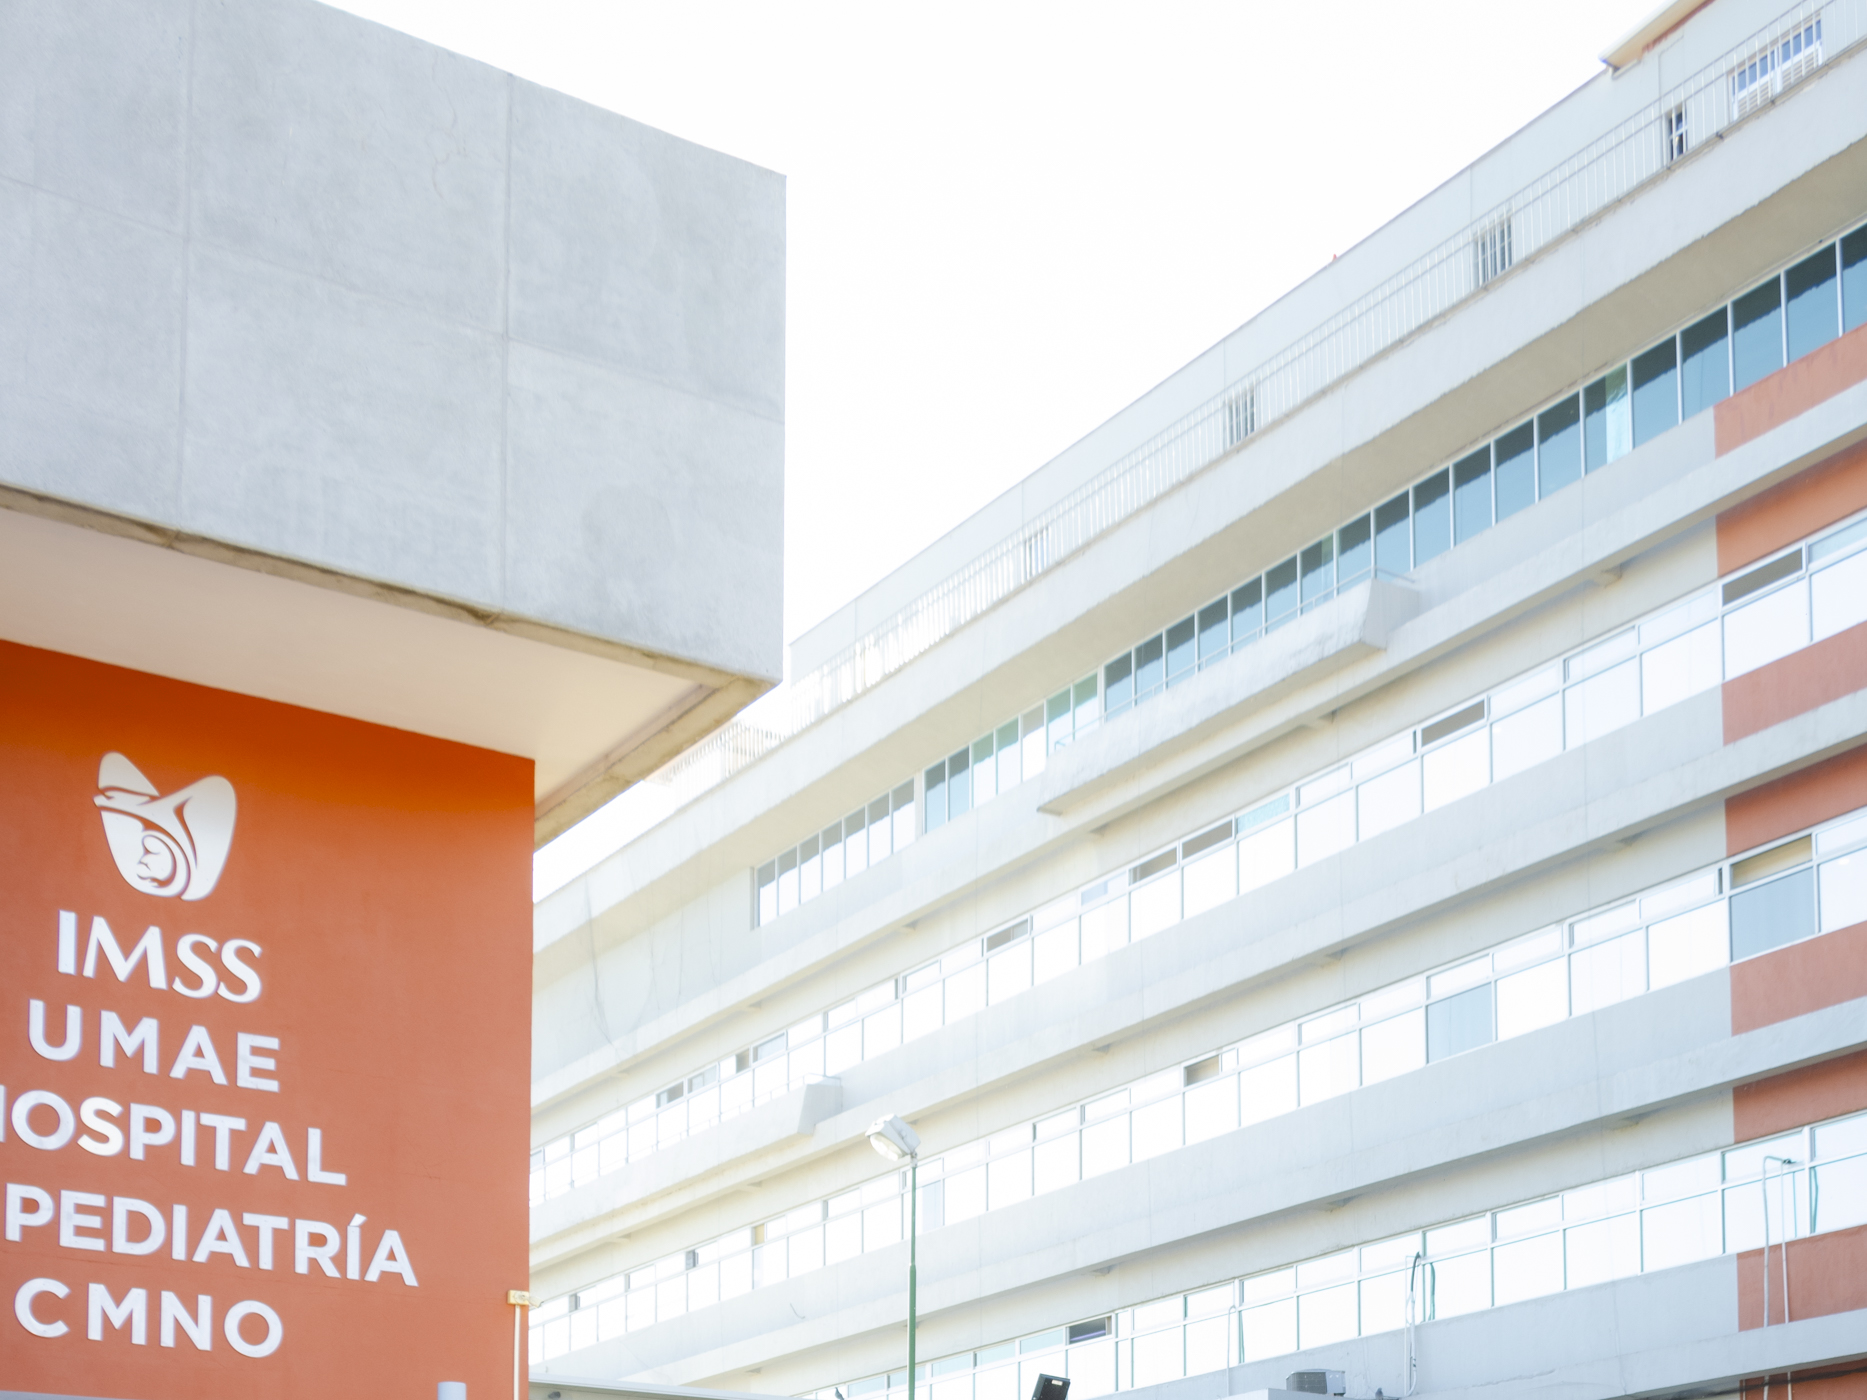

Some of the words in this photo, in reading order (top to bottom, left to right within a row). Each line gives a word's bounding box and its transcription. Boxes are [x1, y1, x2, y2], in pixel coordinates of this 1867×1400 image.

[58, 909, 262, 1003] IMSS
[28, 999, 280, 1093] UMAE
[0, 1084, 347, 1186] OSPITAL
[4, 1183, 419, 1287] PEDIATRÍA
[14, 1277, 284, 1358] CMNO
